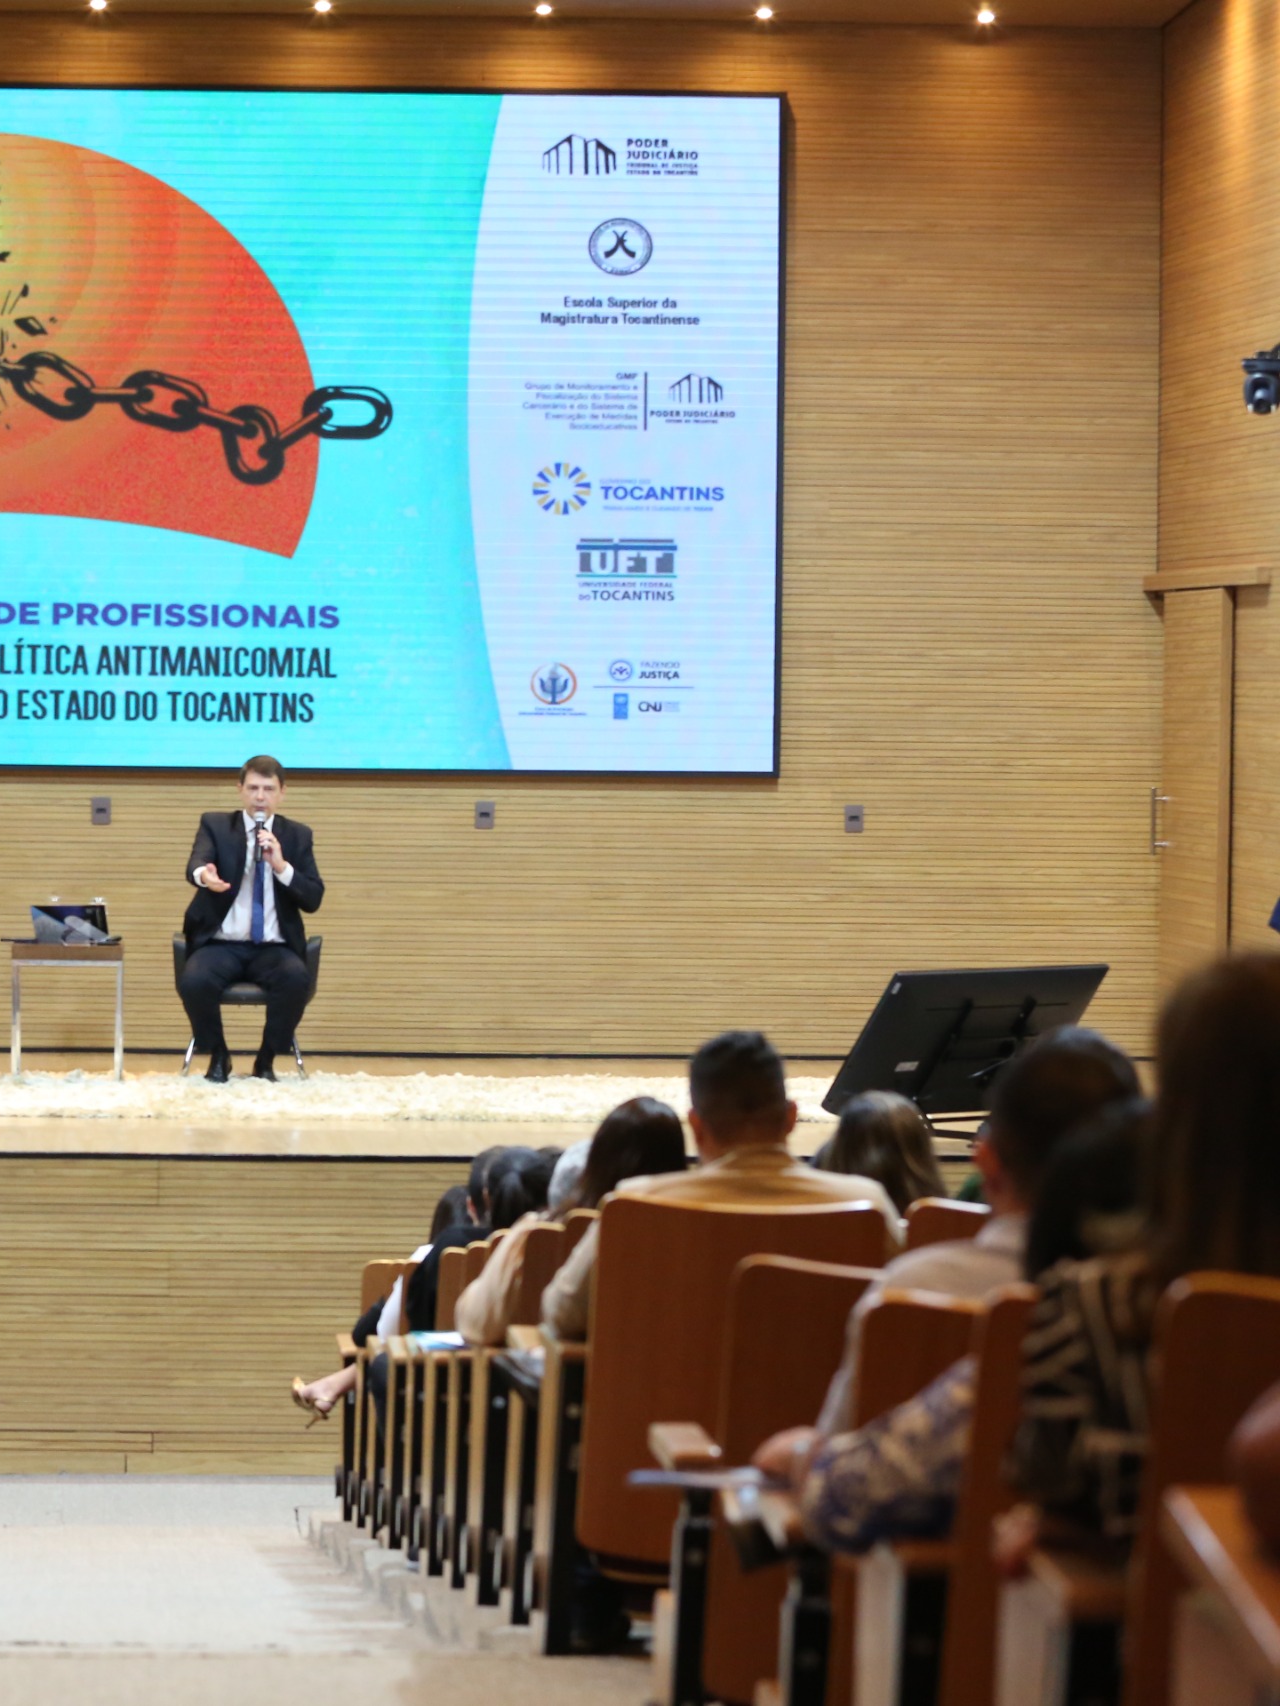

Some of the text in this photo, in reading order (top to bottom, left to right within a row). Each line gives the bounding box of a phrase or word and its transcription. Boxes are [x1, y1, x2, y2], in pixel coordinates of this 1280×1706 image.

[626, 138, 669, 148] PODER
[626, 149, 699, 160] JUDICIÁRIO
[563, 296, 678, 310] Escola Superior da
[540, 312, 701, 326] Magistratura Tocantinense
[649, 409, 736, 418] PODER JUDICIÁRIO
[600, 486, 725, 501] TOCANTINS
[591, 590, 675, 601] TOCANTINS
[52, 603, 340, 629] PROFISSIONAIS
[95, 644, 338, 679] ANTIMANICOMIAL
[638, 671, 680, 680] JUSTIÇA
[17, 689, 117, 721] ESTADO
[124, 690, 158, 721] DO
[167, 691, 315, 723] TOCANTINS
[638, 701, 663, 712] CNJ
